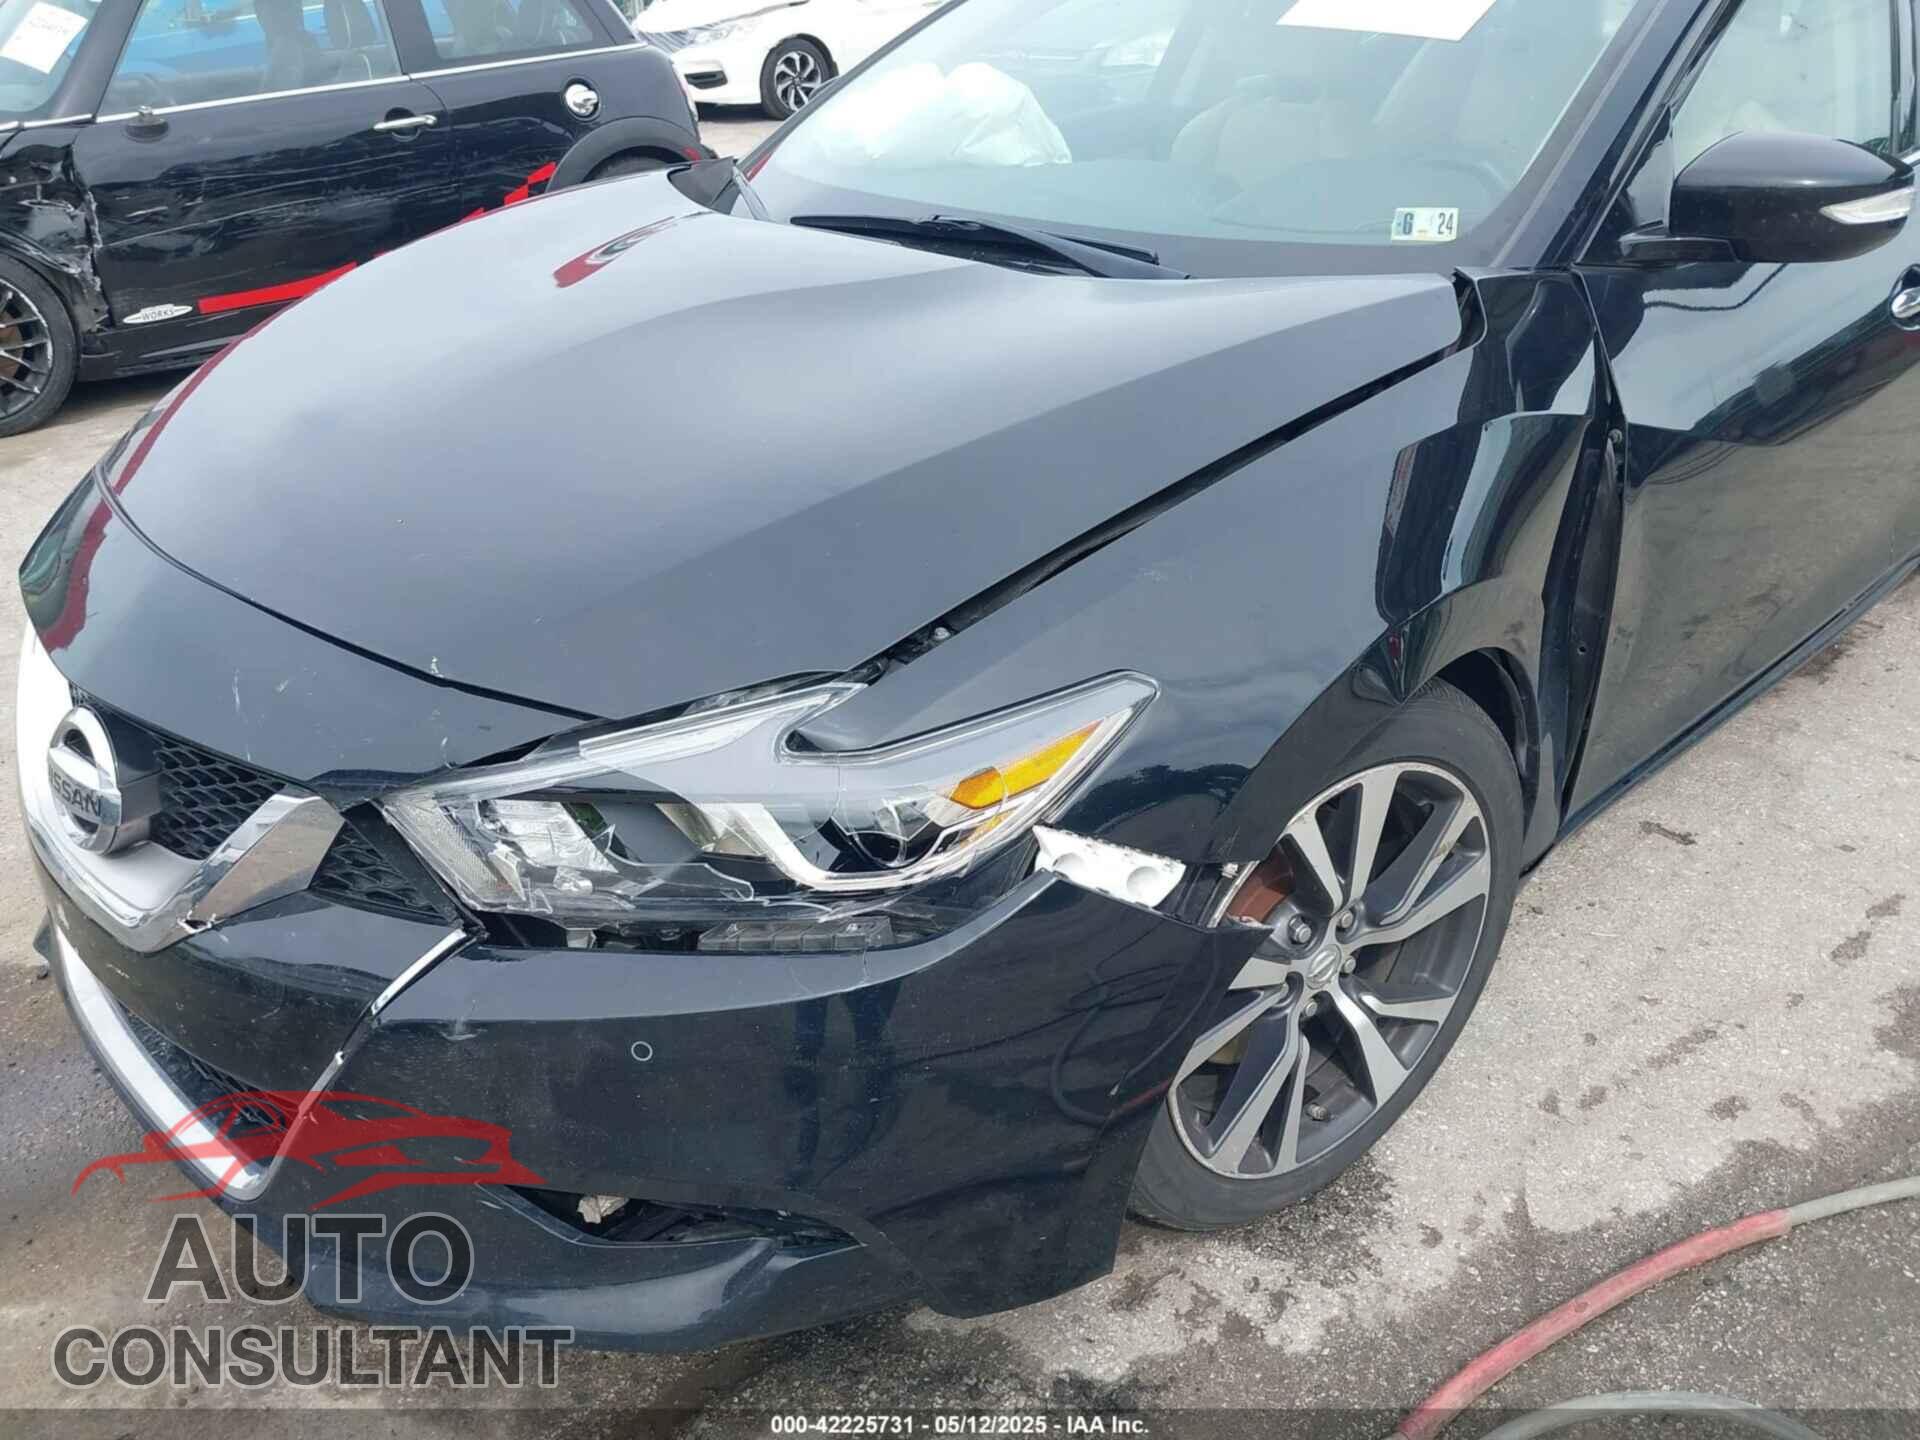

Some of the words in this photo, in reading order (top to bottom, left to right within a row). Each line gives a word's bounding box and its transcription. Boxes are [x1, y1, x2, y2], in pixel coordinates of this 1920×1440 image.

[1437, 212, 1454, 236] 24
[142, 309, 175, 320] WORKS
[48, 766, 102, 817] ISSAN
